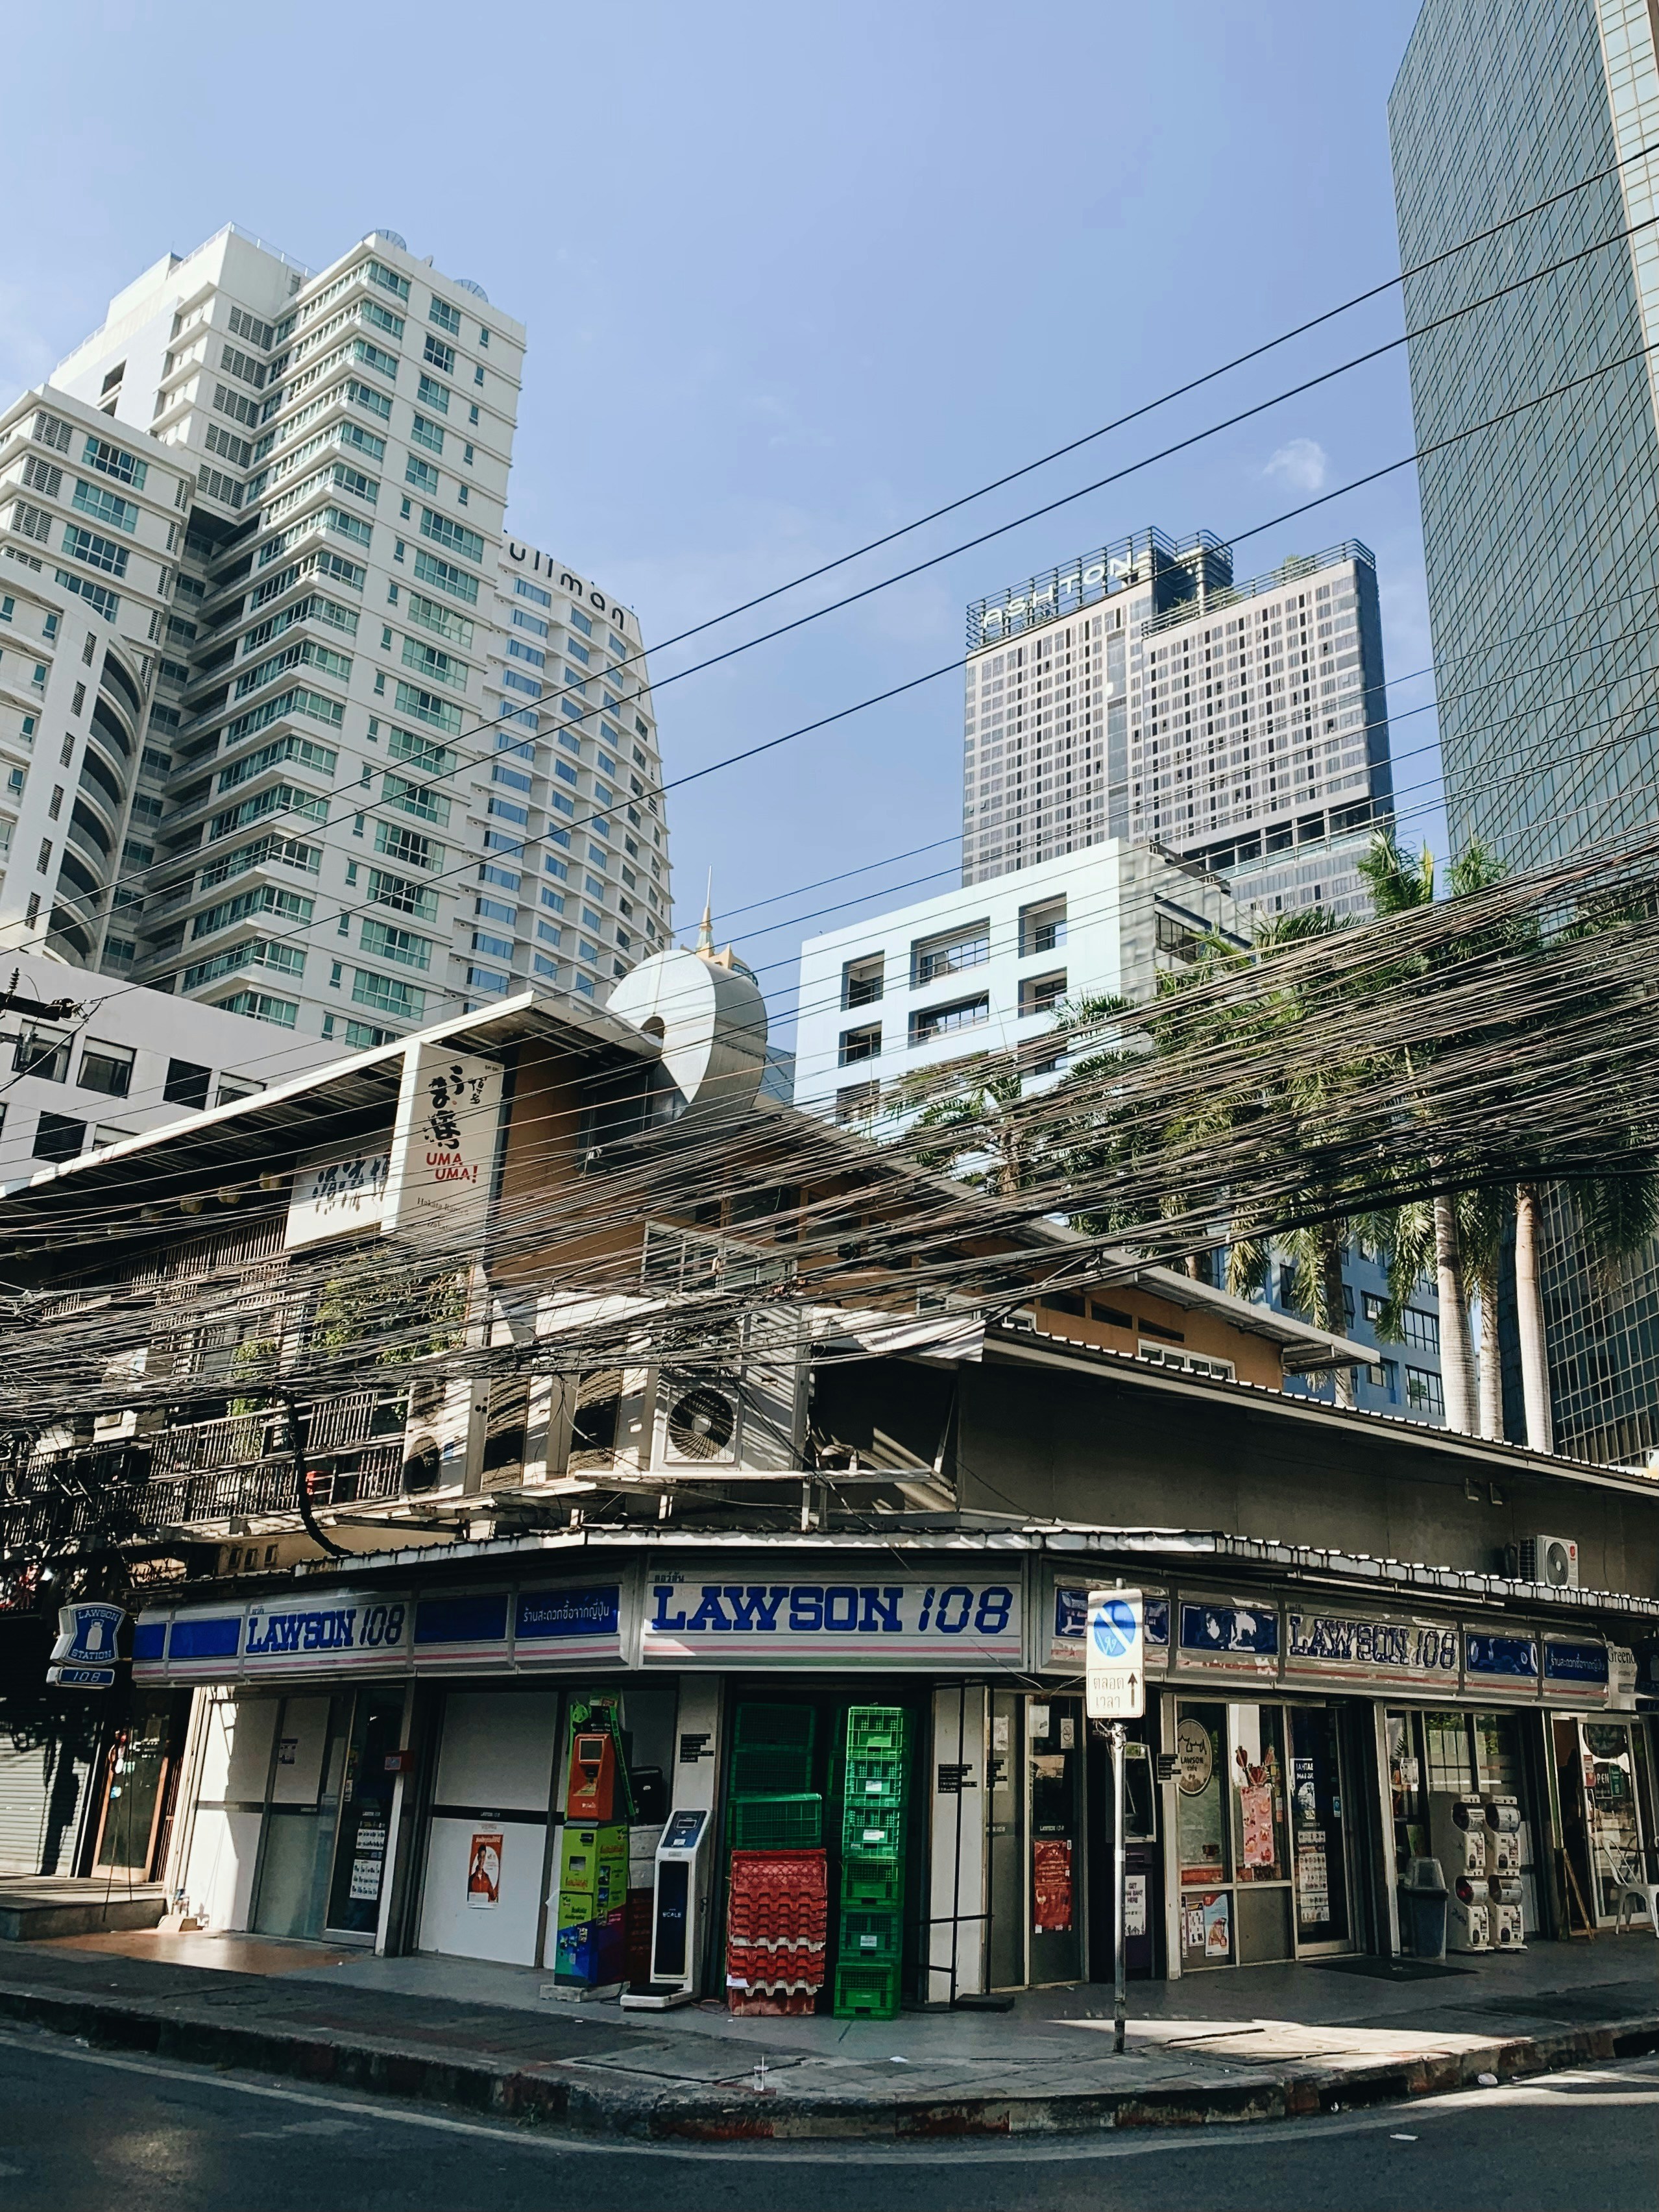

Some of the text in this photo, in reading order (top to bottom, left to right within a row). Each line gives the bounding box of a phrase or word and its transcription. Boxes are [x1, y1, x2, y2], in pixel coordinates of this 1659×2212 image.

[509, 542, 624, 631] ullman
[982, 551, 1133, 629] ASHTON
[426, 1152, 463, 1167] UMA
[435, 1165, 478, 1184] UMA!
[78, 1609, 119, 1622] LAWSON
[652, 1586, 904, 1631] LAWSON
[918, 1586, 1013, 1634] 108
[246, 1603, 406, 1654] LAWSON 108
[1289, 1613, 1457, 1670] LAWSON 108
[71, 1649, 112, 1660] STATION
[73, 1671, 101, 1683] 108
[1093, 1677, 1124, 1690] ตลอด
[1096, 1695, 1120, 1708] เวลา
[1180, 1756, 1204, 1764] LAWSON
[1597, 1773, 1610, 1784] PEN
